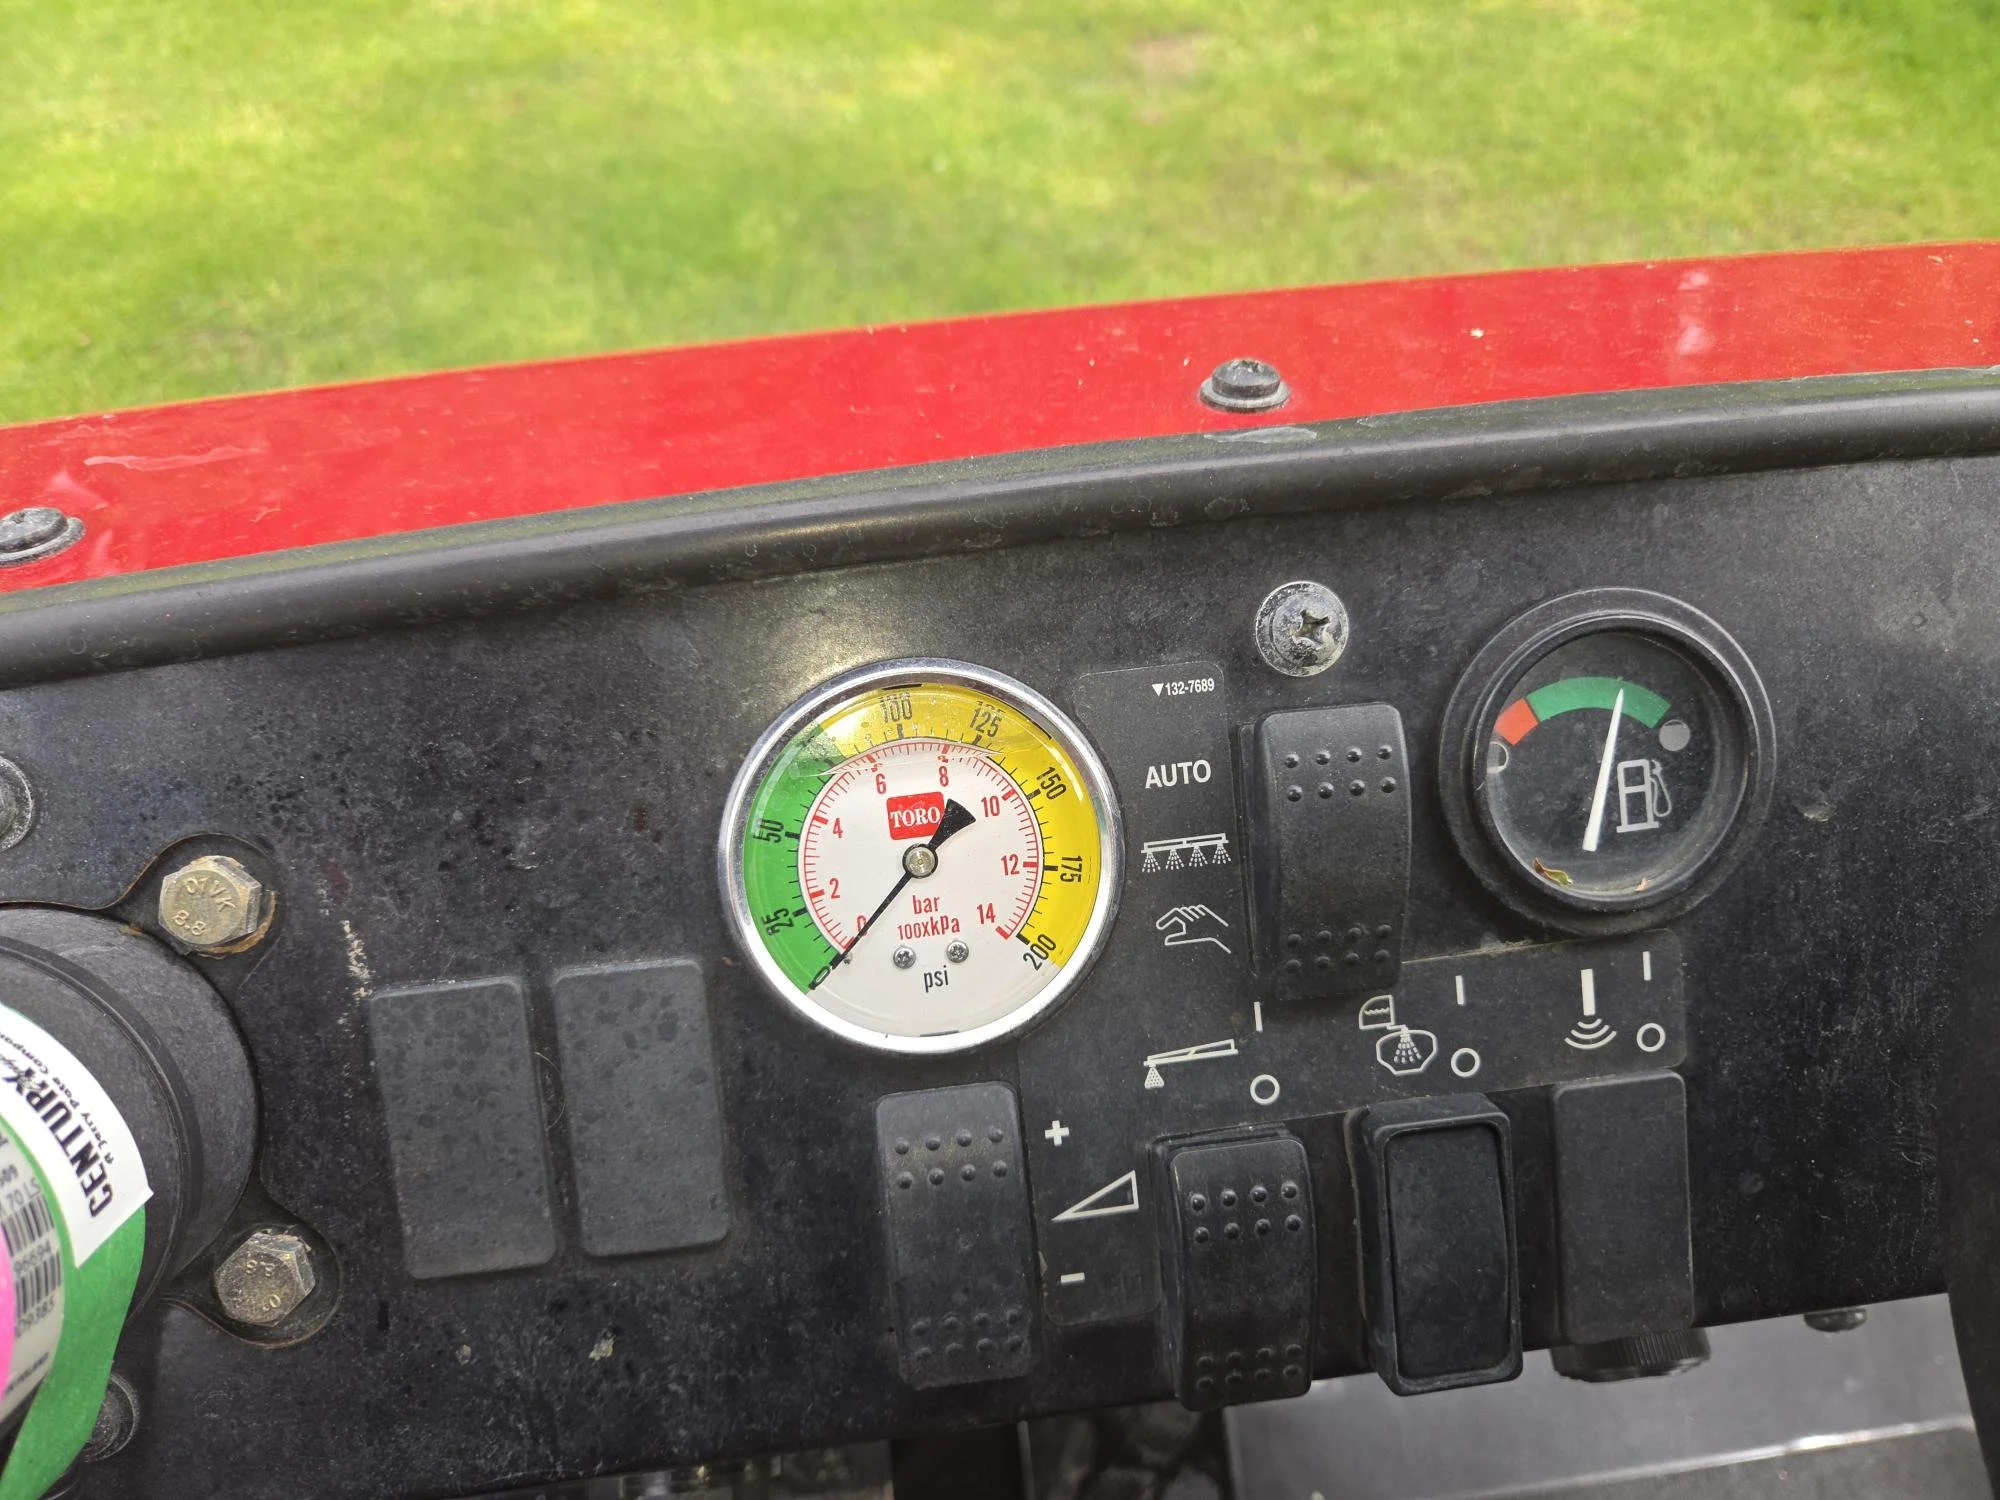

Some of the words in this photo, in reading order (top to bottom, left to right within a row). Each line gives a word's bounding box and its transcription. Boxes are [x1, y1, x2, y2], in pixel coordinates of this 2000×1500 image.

[1165, 678, 1215, 696] 132-7689
[880, 692, 913, 723] 100
[969, 704, 1003, 738] 125
[875, 773, 887, 795] 6
[938, 766, 949, 787] 8
[1036, 766, 1067, 801] 150
[1145, 759, 1212, 789] AUTO
[890, 806, 942, 829] TORO
[981, 795, 1001, 818] 10
[752, 819, 785, 844] 50
[832, 817, 844, 839] 4
[1001, 853, 1021, 876] 12
[1060, 855, 1083, 884] 175
[829, 877, 841, 899] 2
[912, 895, 940, 915] bar
[976, 902, 996, 925] 14
[173, 909, 207, 936] 8.8
[1022, 933, 1057, 971] 200
[923, 965, 950, 993] psi
[52, 1076, 81, 1110] Pate
[1, 1066, 114, 1218] CENTURY
[80, 1111, 109, 1150] Jerry
